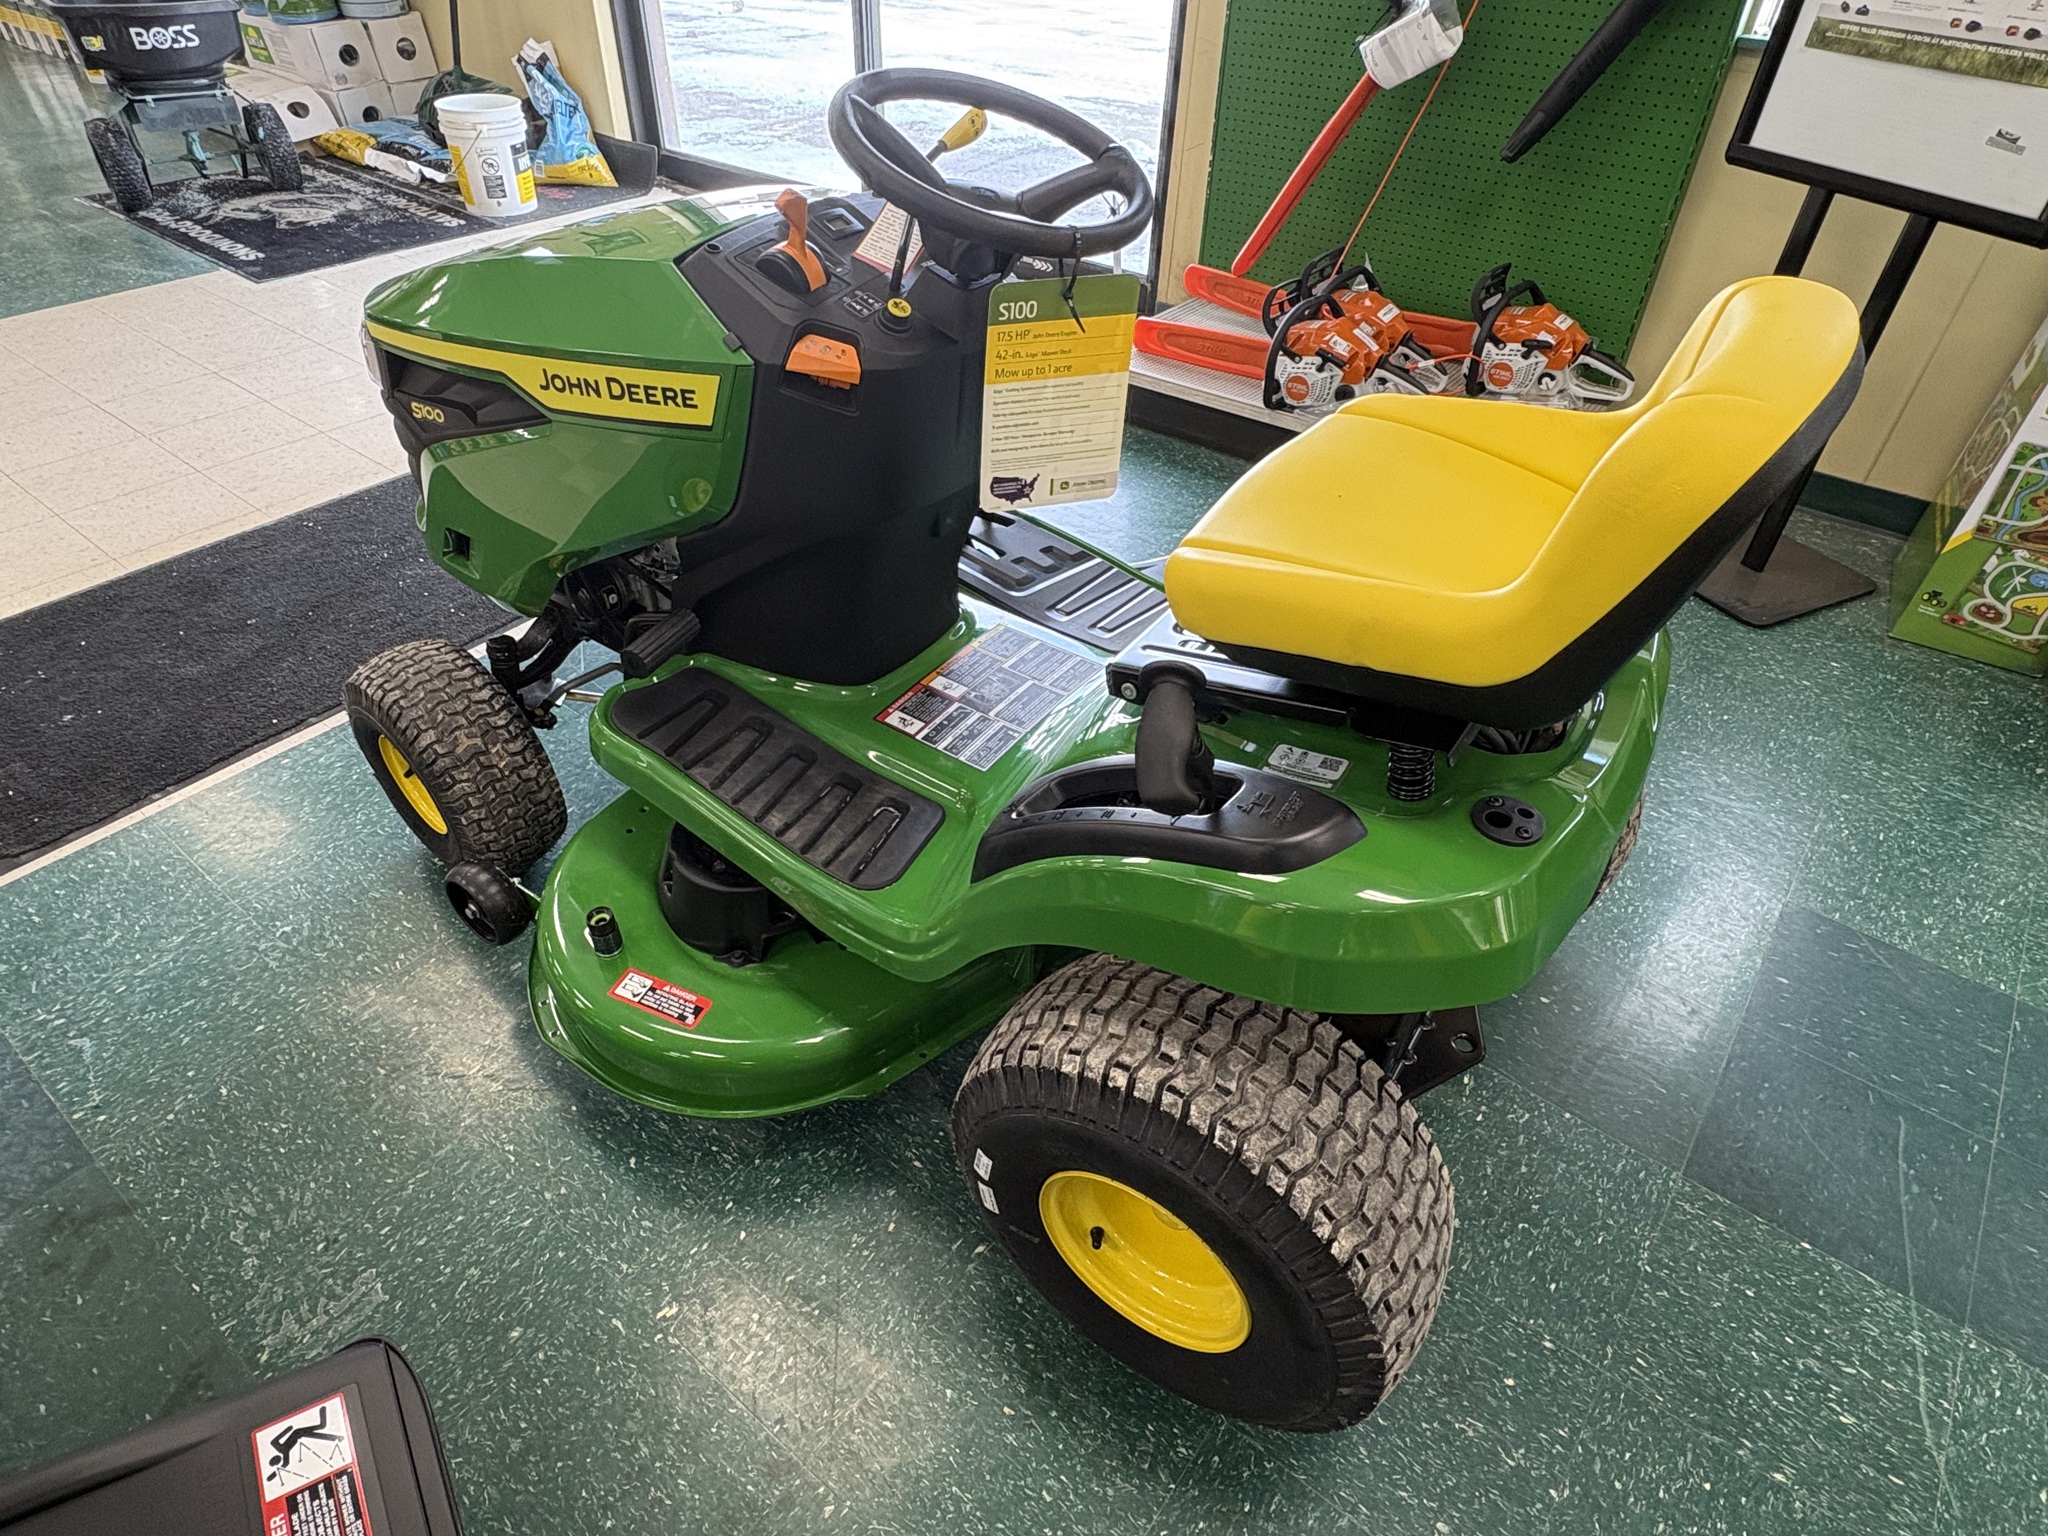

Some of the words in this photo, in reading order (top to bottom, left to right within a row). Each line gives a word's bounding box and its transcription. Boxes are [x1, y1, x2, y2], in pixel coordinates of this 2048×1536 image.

[129, 24, 200, 51] BOSS
[1940, 38, 1987, 52] PARTICIPATING
[1988, 45, 2022, 57] RETAILERS
[998, 300, 1038, 321] S100
[995, 367, 1020, 379] Mow
[1021, 368, 1034, 378] up
[1035, 365, 1046, 375] to
[1047, 363, 1052, 374] 1
[1052, 364, 1073, 373] acre
[1490, 368, 1512, 379] STIHL
[539, 368, 602, 399] JOHN
[605, 377, 699, 410] DEERE
[1287, 381, 1309, 392] STIHL
[410, 401, 445, 424] S100
[670, 985, 698, 1003] DANGER
